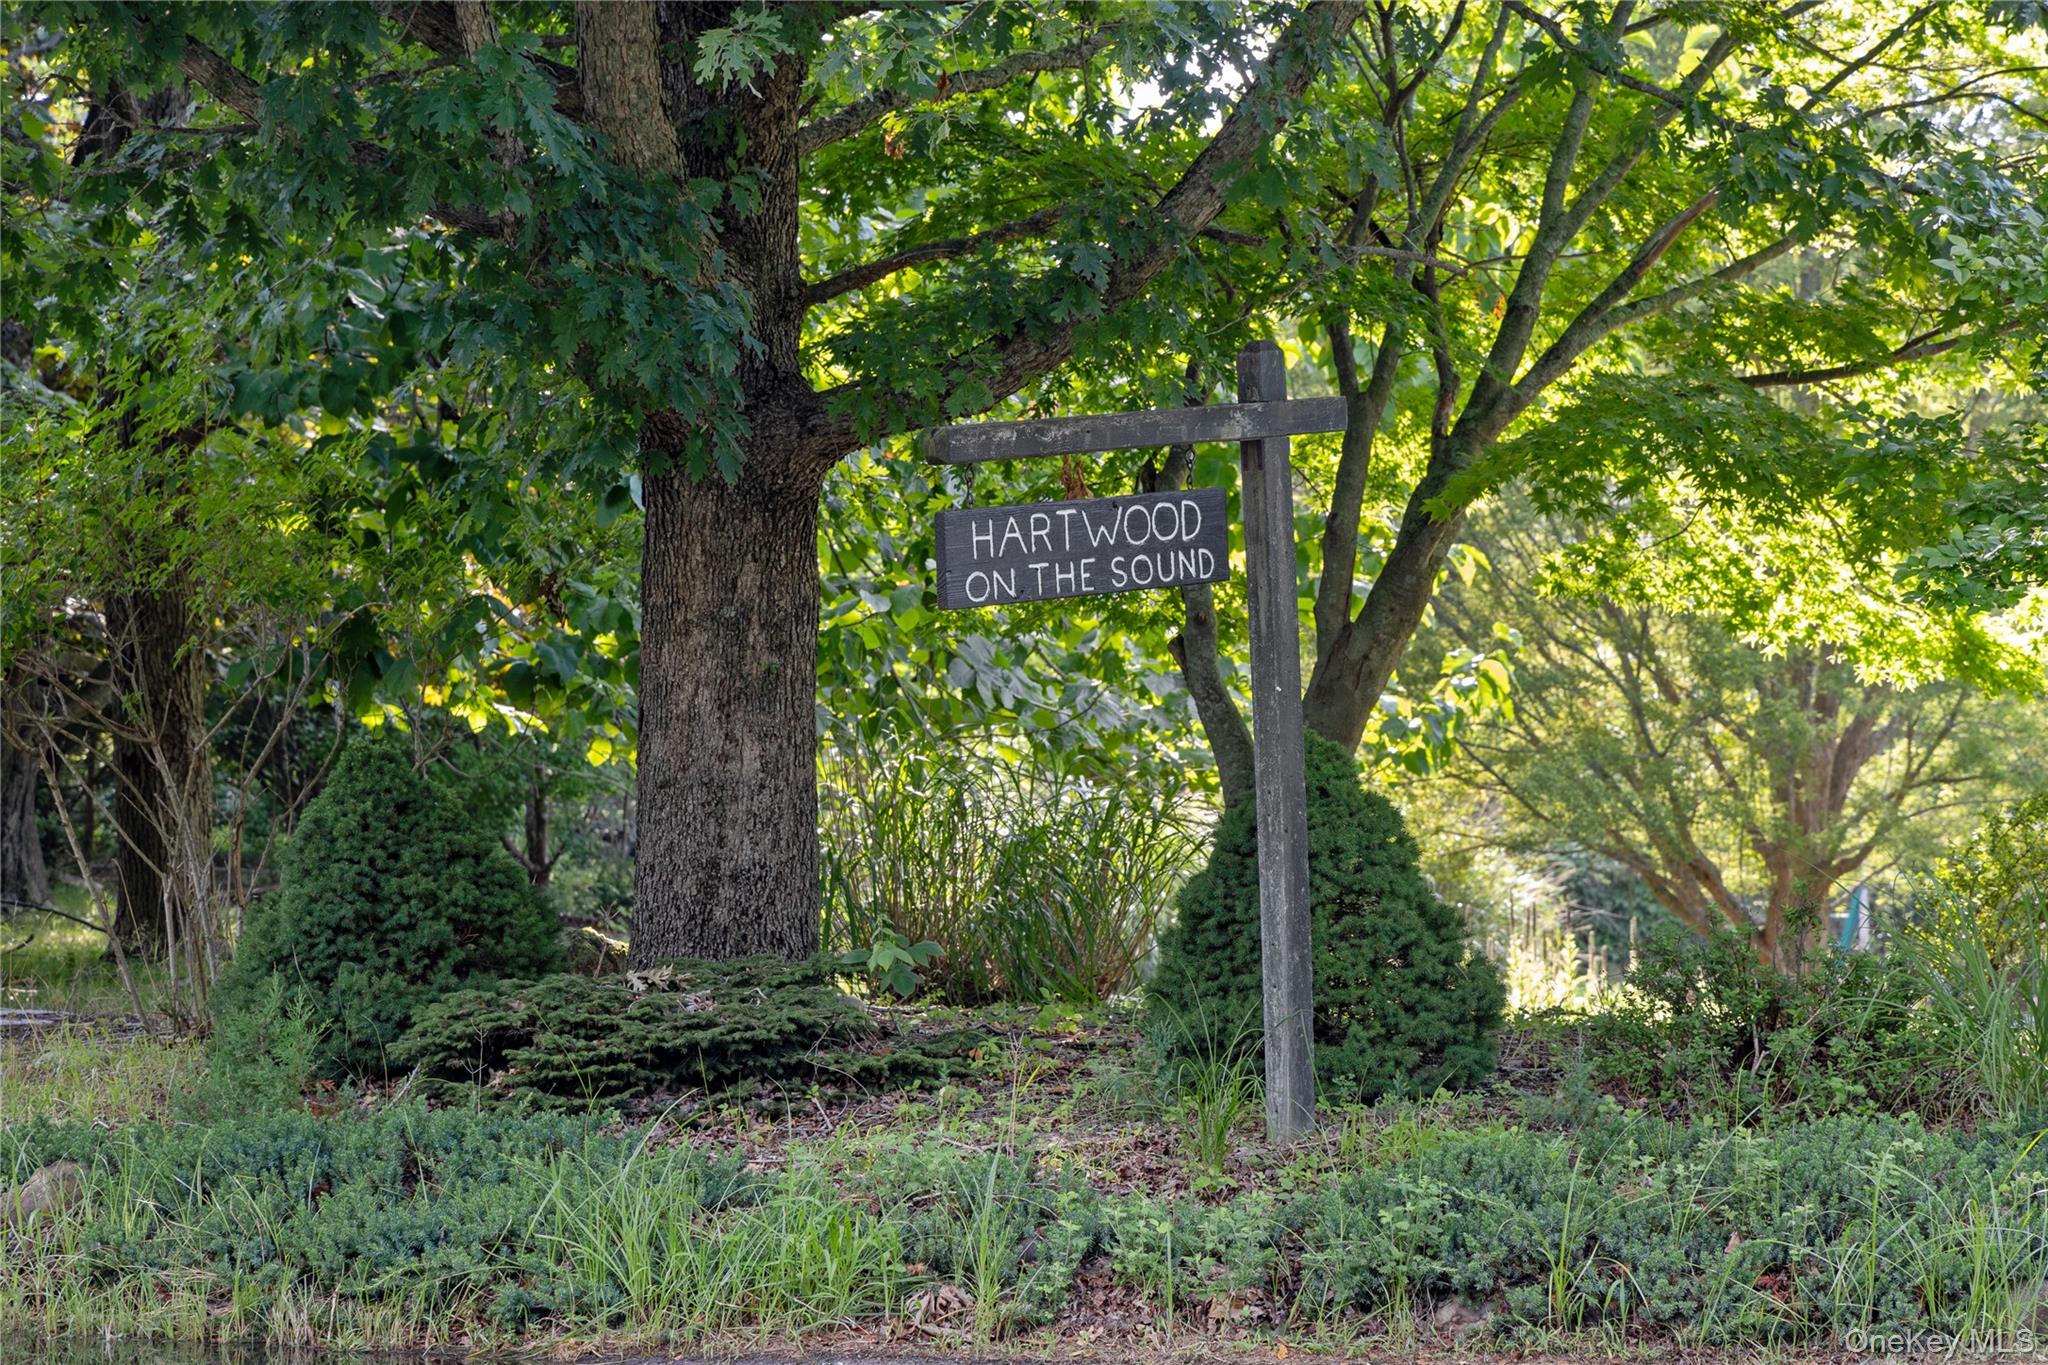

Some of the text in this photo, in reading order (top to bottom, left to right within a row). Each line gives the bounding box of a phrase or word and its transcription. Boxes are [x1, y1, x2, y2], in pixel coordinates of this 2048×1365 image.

[971, 499, 1202, 560] HARTWOOD
[965, 548, 1215, 602] ON THE SOUND
